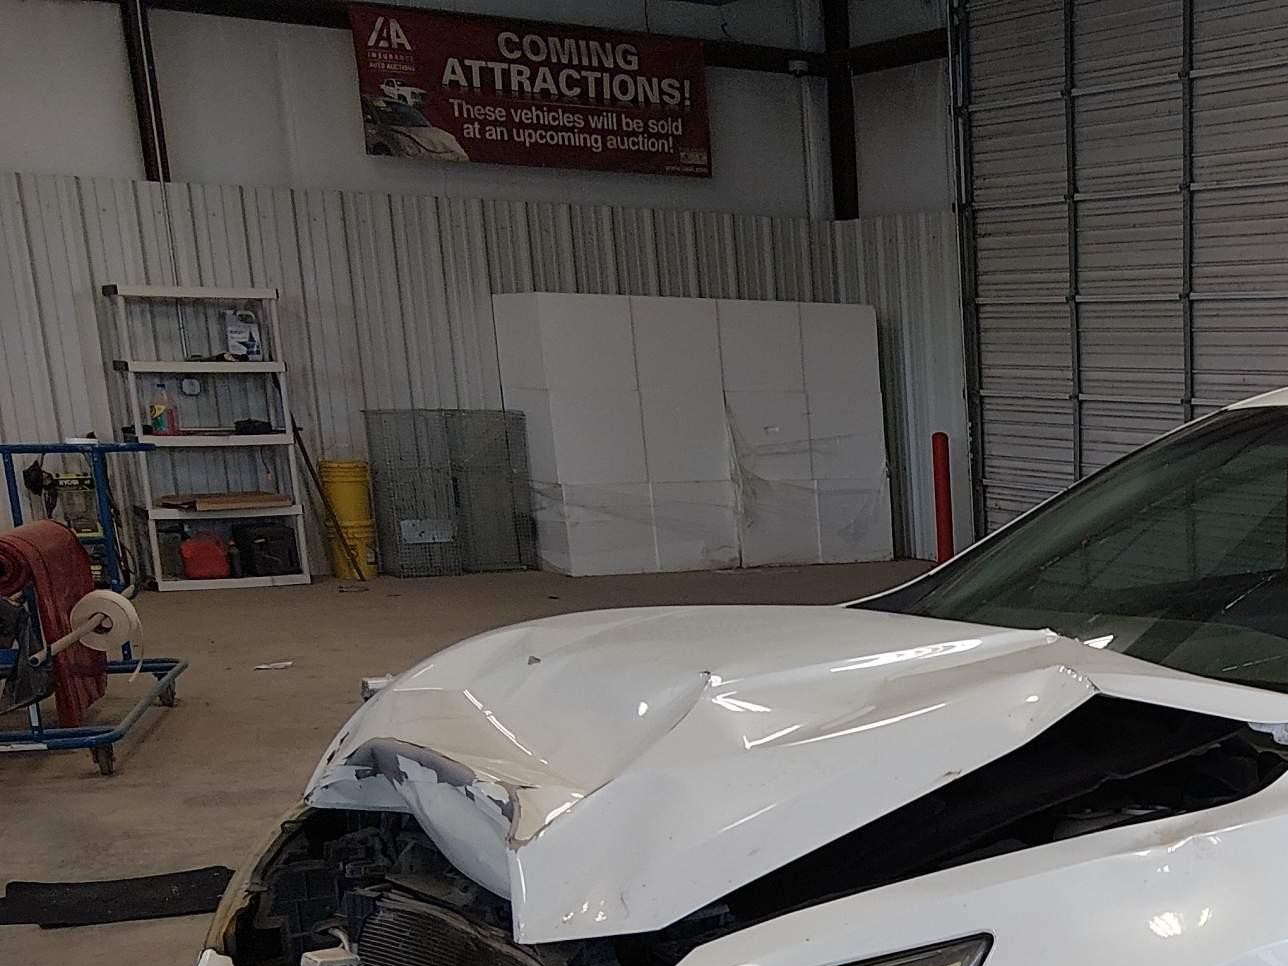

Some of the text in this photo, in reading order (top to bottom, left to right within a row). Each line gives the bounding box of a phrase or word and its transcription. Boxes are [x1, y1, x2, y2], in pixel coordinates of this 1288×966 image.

[497, 31, 639, 71] COMING
[441, 57, 691, 106] ATTRACTIONS!
[448, 98, 683, 136] These vehicles will be sold
[463, 123, 674, 153] at an upcoming auction!
